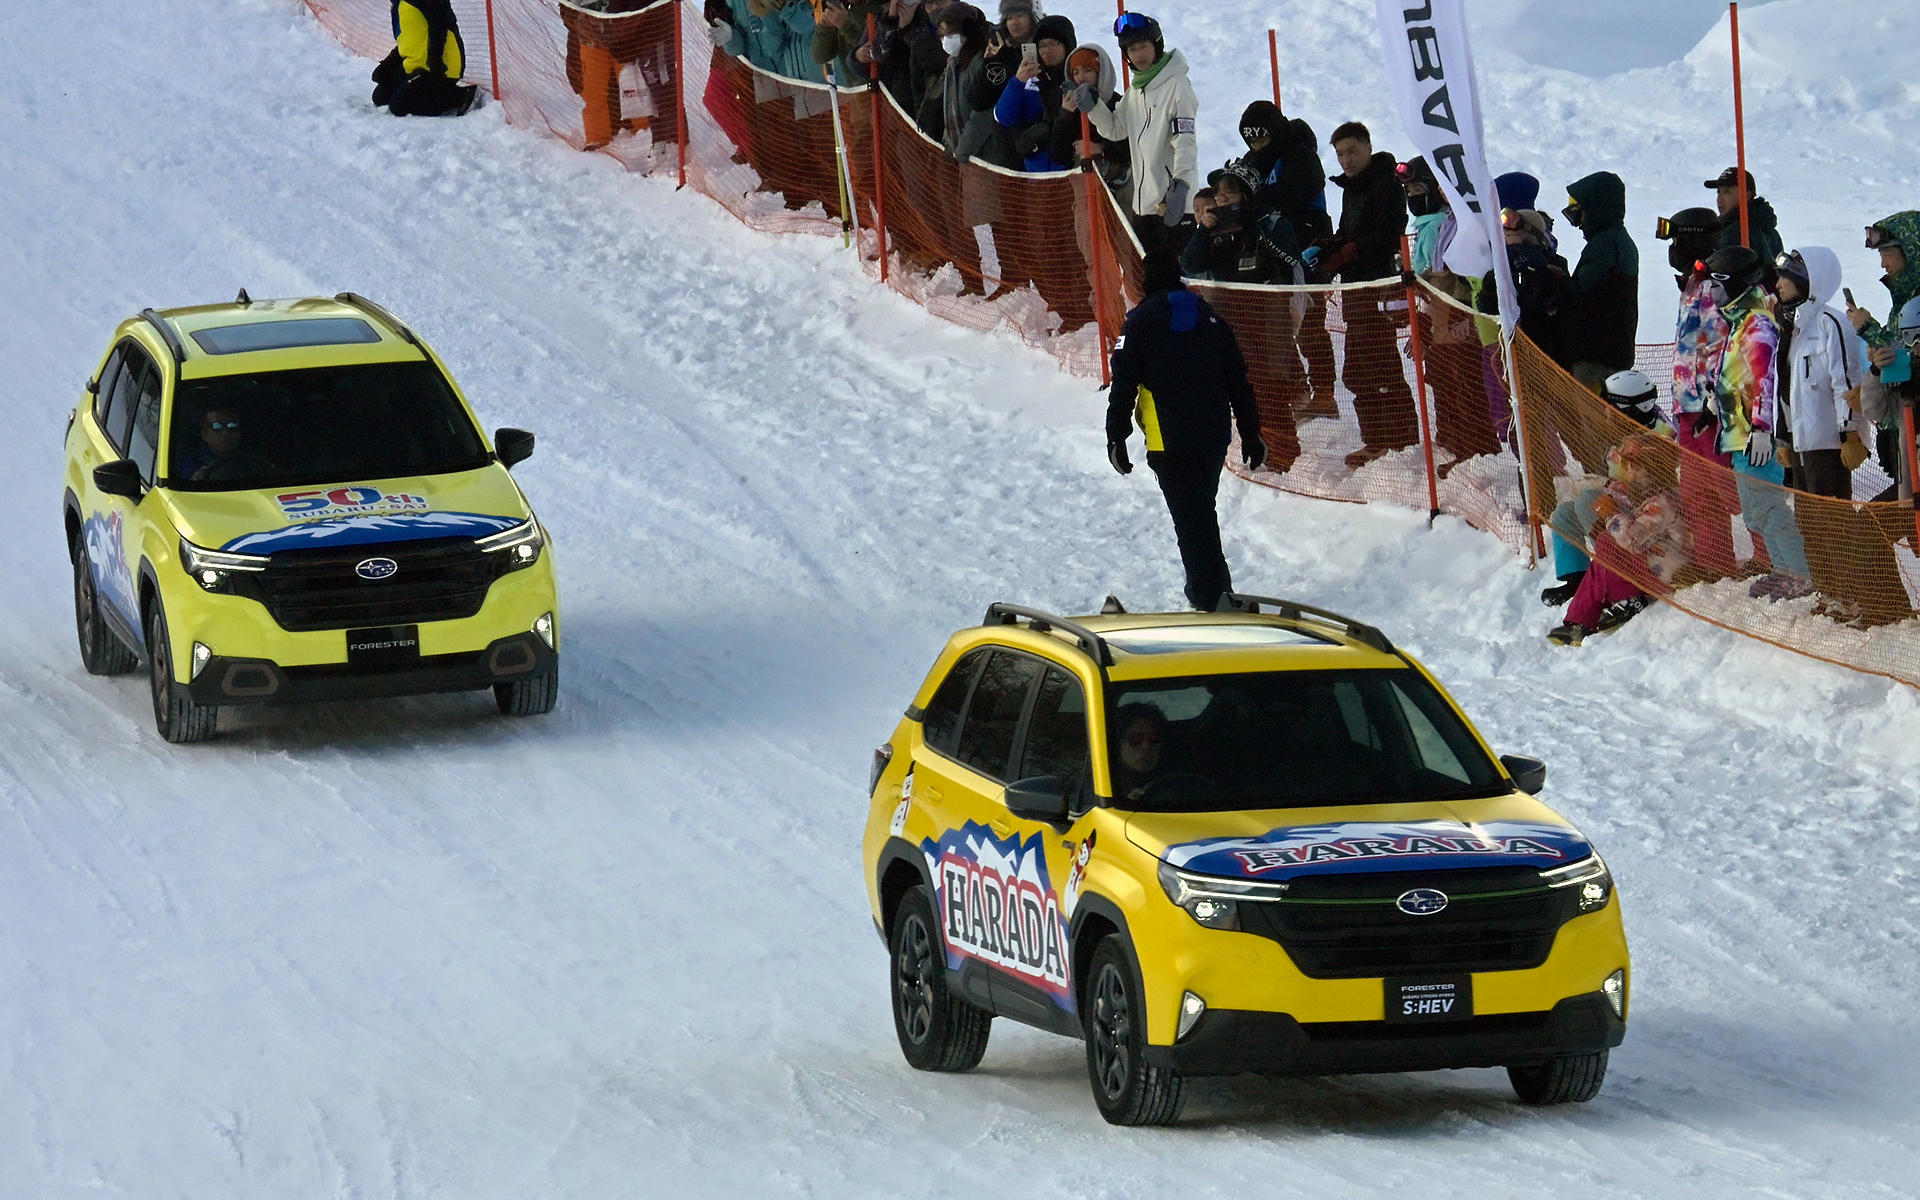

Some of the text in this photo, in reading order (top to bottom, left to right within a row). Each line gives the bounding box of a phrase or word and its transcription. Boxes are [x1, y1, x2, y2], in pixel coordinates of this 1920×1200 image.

[277, 487, 425, 512] 50th
[289, 505, 374, 520] SUBARU
[350, 639, 416, 651] FORESTER
[1236, 836, 1560, 872] HARADA
[944, 865, 1067, 983] HARADA
[1401, 984, 1455, 992] FORESTER
[1403, 999, 1454, 1015] S:HEV
